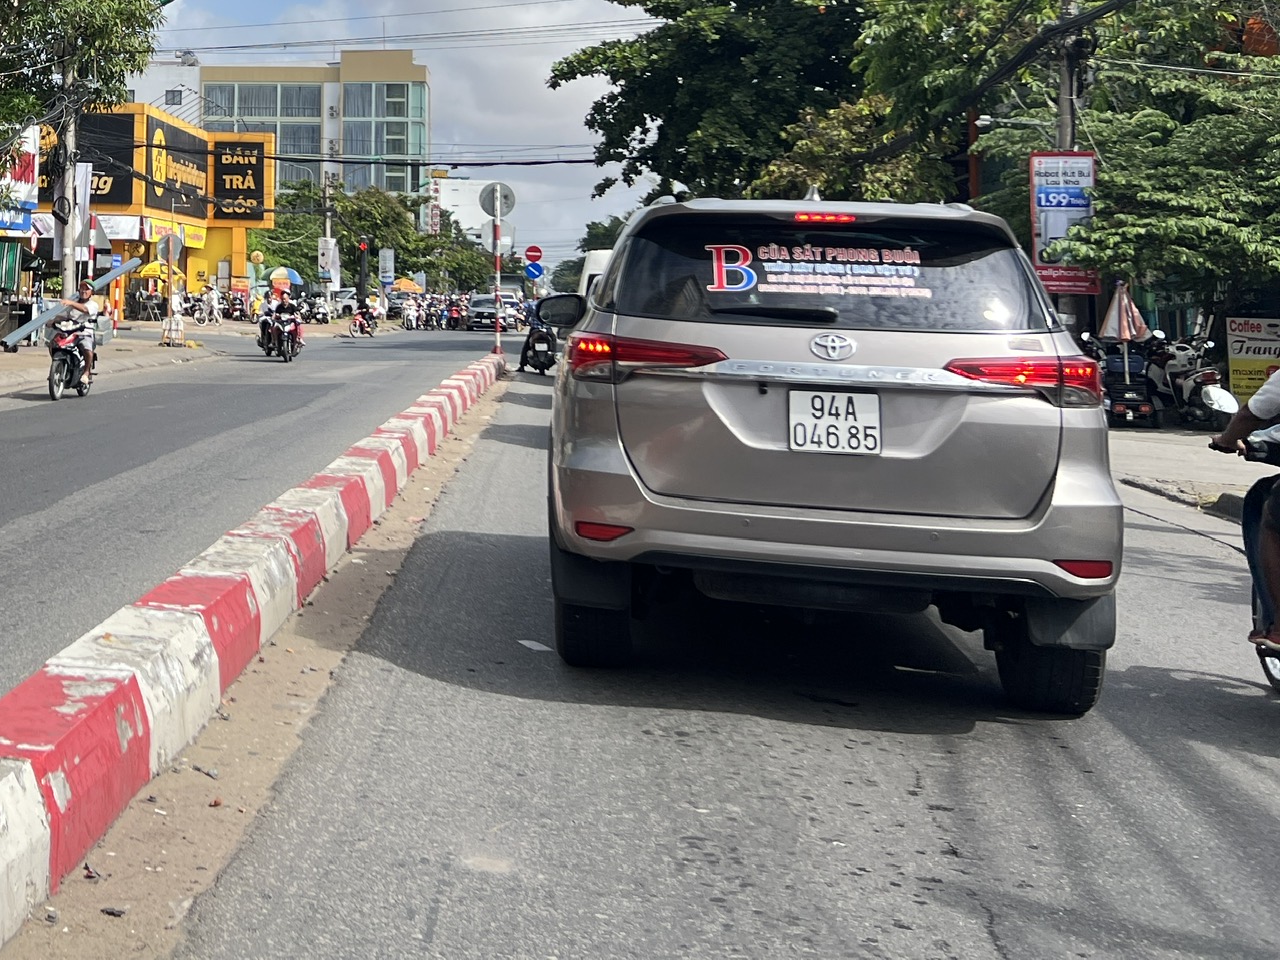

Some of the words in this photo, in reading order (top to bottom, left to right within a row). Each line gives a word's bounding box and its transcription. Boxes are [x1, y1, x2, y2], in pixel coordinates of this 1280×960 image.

[223, 170, 256, 189] TRẢ
[1038, 193, 1070, 206] 1.99
[825, 247, 879, 262] PHONG
[704, 244, 758, 292] B
[1229, 320, 1262, 333] Coffee
[733, 363, 936, 381] FORTUNER
[811, 395, 857, 422] 94A
[793, 422, 877, 450] 046.85
